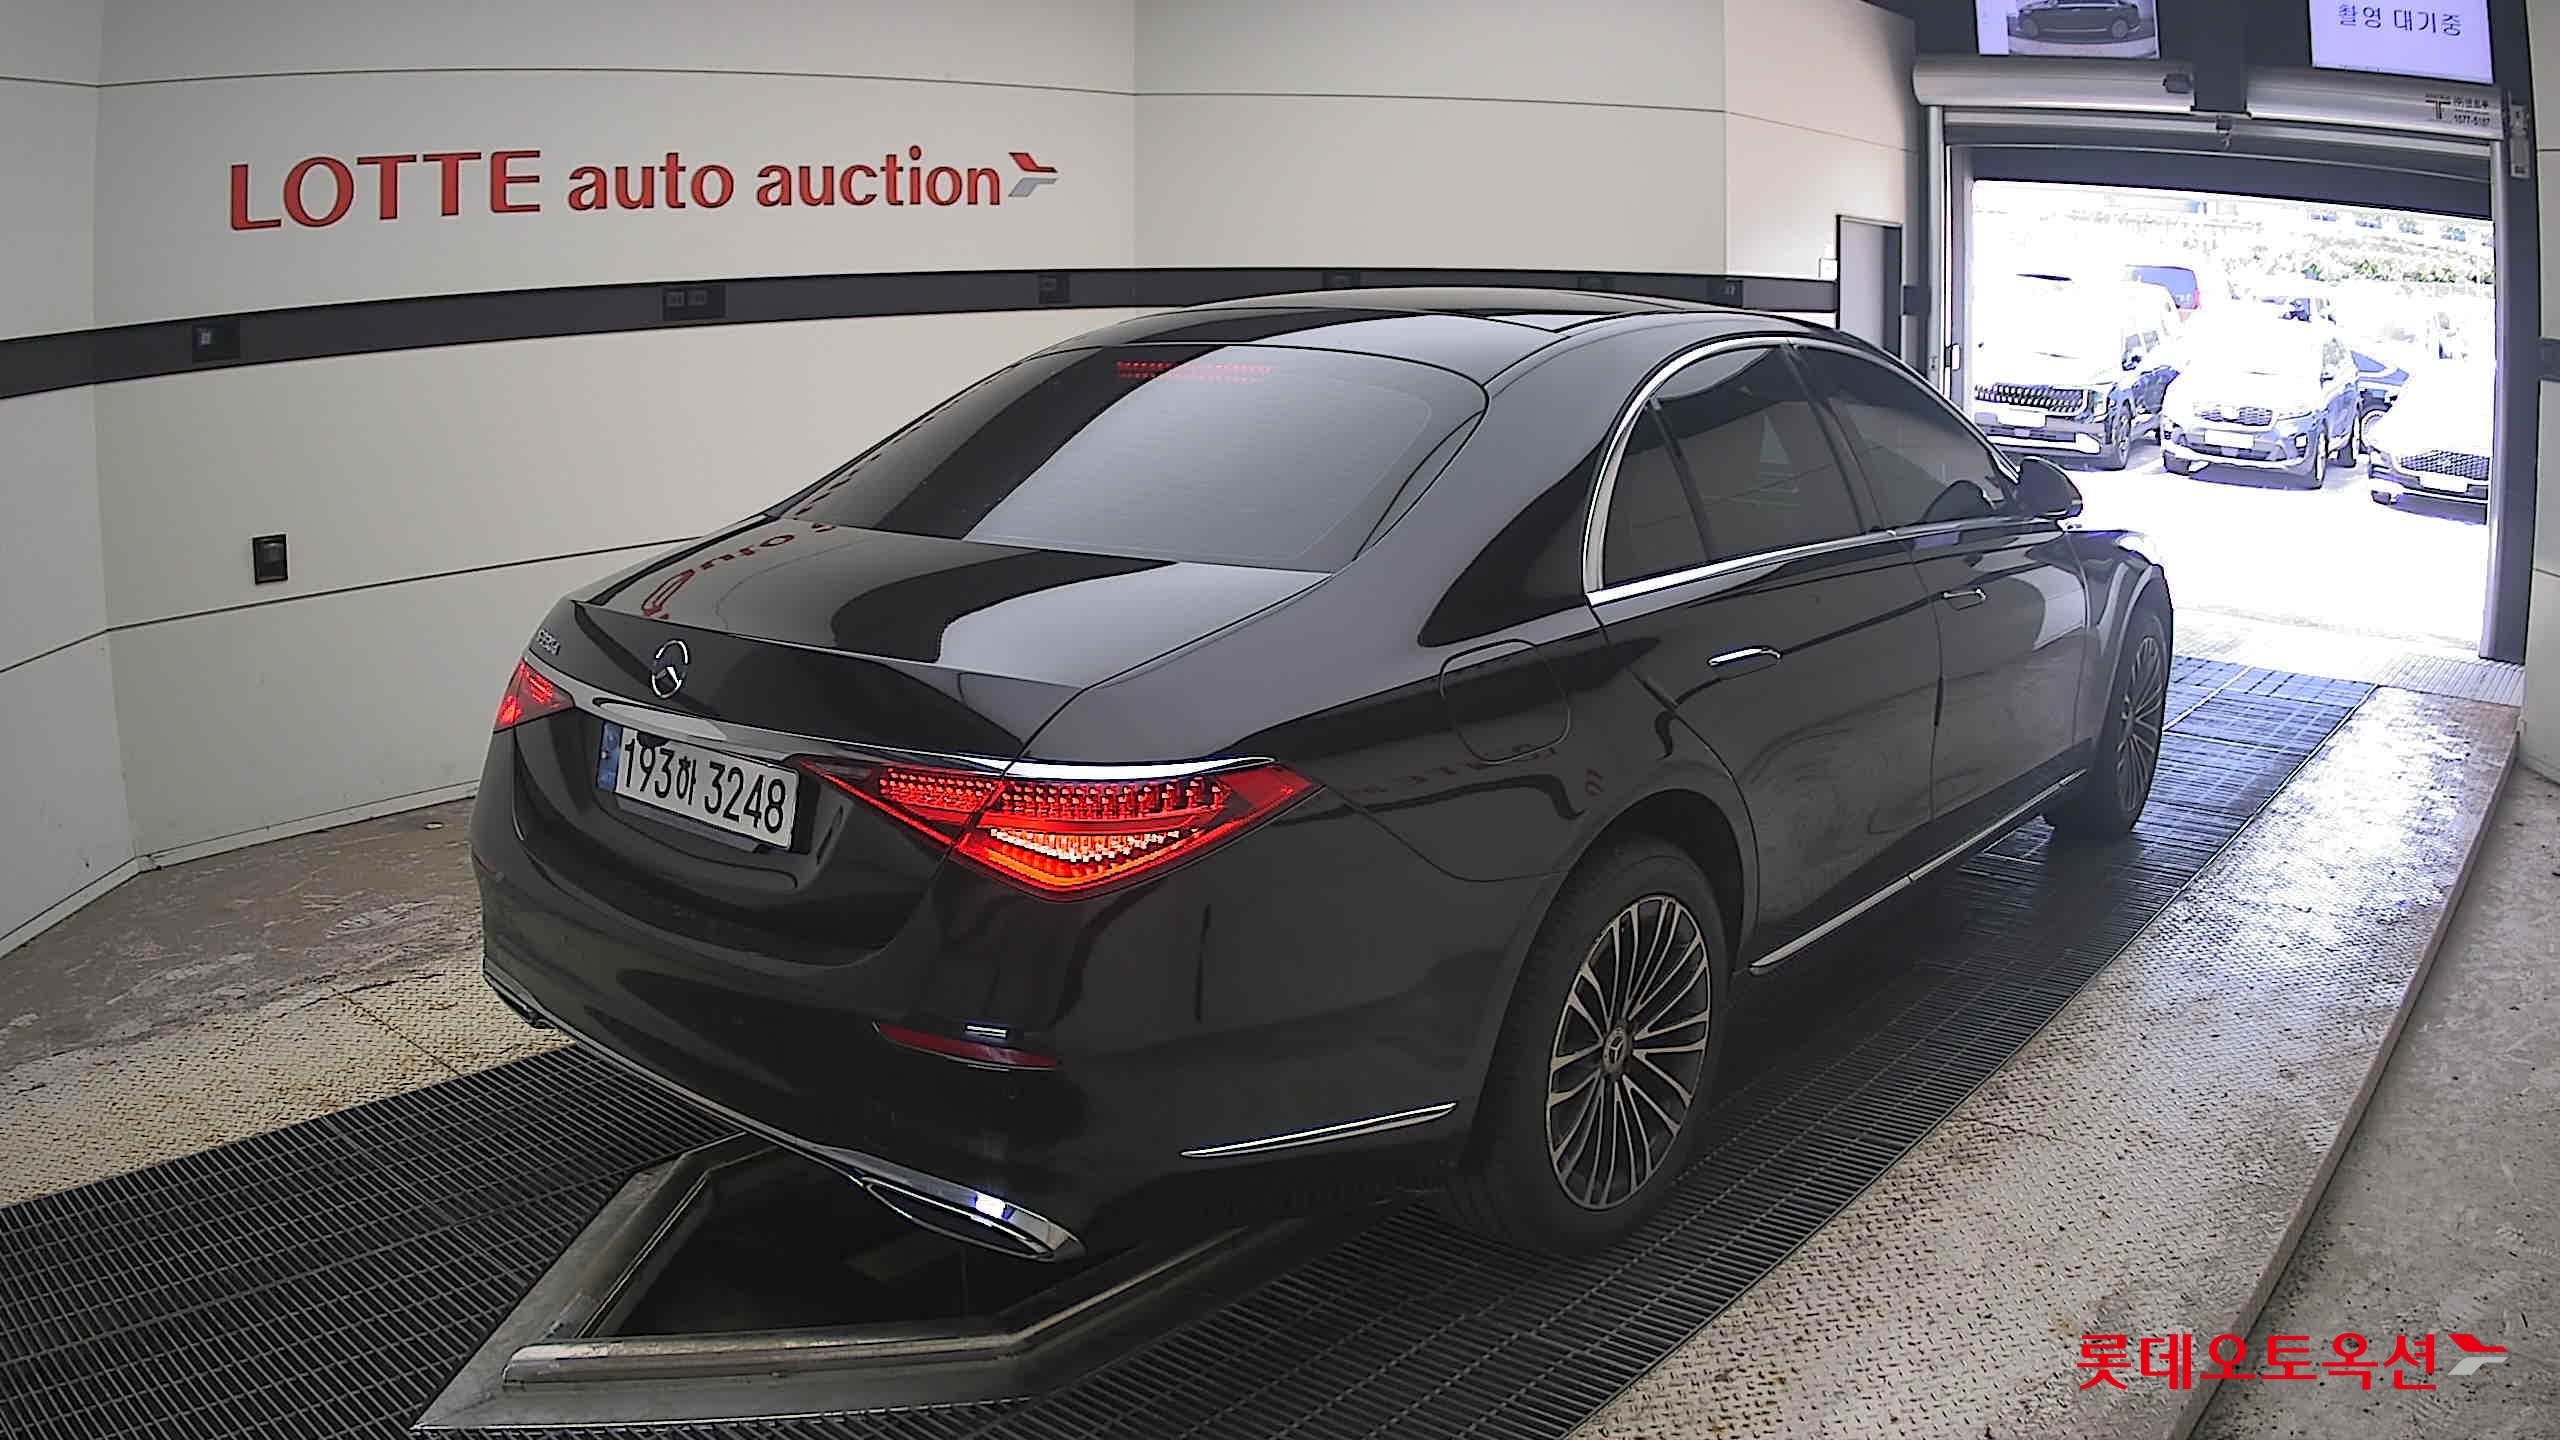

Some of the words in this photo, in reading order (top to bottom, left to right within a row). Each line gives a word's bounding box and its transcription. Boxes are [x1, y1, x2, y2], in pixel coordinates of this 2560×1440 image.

[2393, 8, 2462, 37] 대기중
[230, 149, 541, 231] LOTTE
[567, 151, 735, 211] auto
[755, 144, 1001, 207] auction
[624, 738, 697, 806] 193하
[704, 760, 787, 834] 3248
